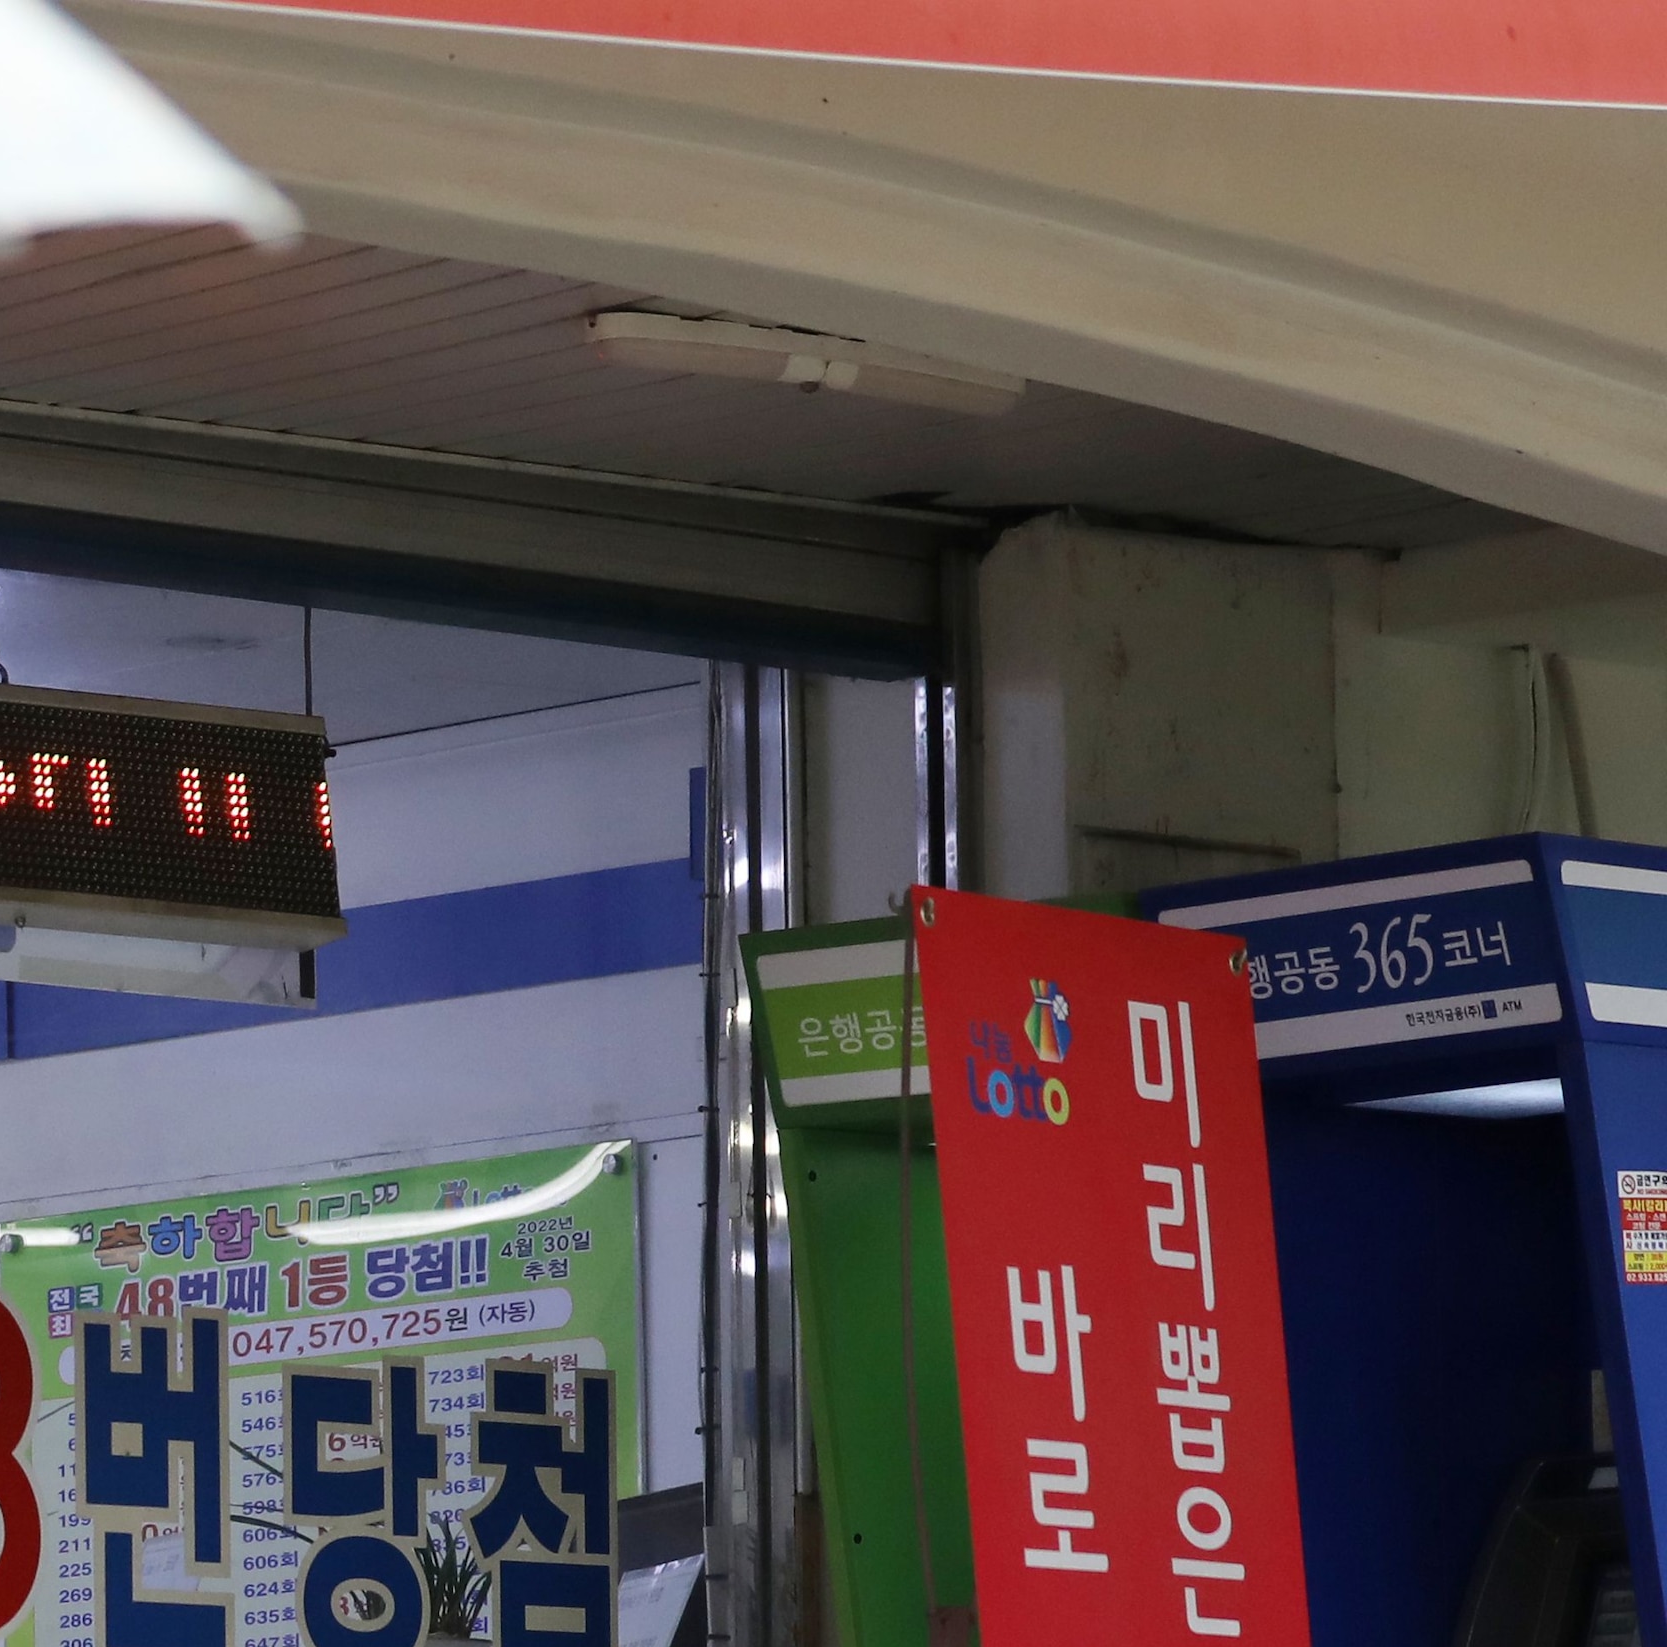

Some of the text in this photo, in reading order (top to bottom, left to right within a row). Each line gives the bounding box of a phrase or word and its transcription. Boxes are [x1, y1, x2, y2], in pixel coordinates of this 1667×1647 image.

[1349, 914, 1433, 993] 365
[1443, 921, 1511, 967] 코너
[1502, 1001, 1522, 1013] ATM
[967, 1056, 1069, 1126] Lotto
[518, 1216, 574, 1235] 2022년
[501, 1231, 591, 1258] 4월 30일
[282, 1253, 349, 1309] 1등
[367, 1235, 489, 1300] 당첨!!
[523, 1258, 568, 1281] 추첨
[479, 1299, 536, 1326] (자동)
[428, 1364, 484, 1385] 723회
[429, 1392, 485, 1413] 734회
[1006, 1265, 1109, 1572] 바로
[243, 1550, 298, 1571] 606회
